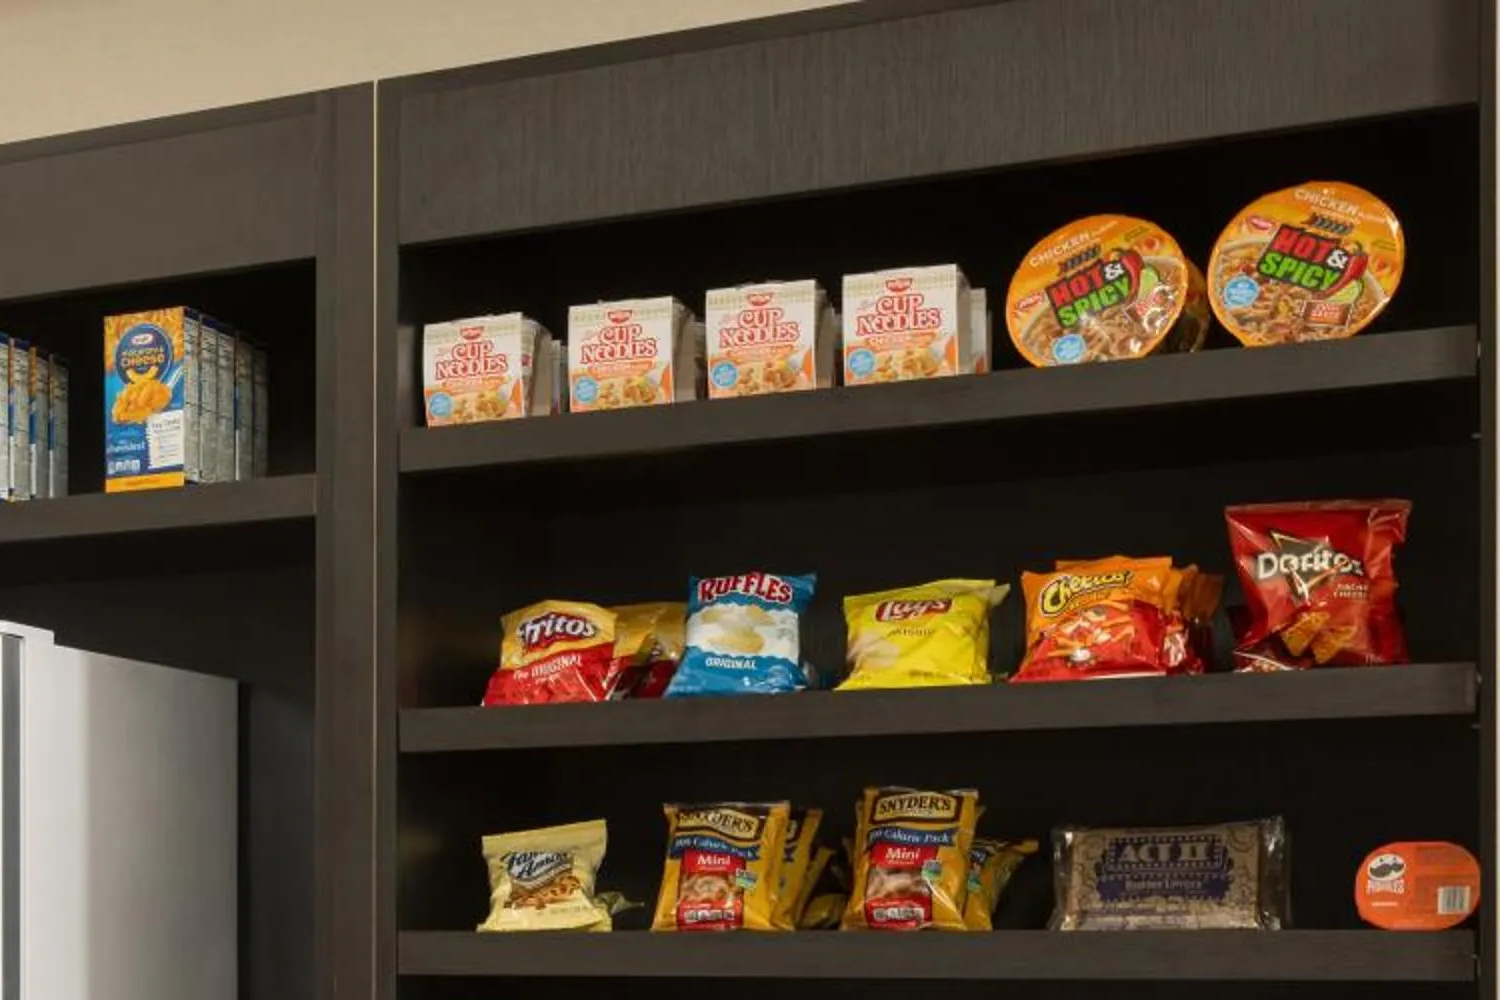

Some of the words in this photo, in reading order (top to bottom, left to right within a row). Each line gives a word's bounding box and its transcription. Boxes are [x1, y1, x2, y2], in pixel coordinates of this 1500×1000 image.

[1029, 232, 1091, 268] CHICKEN
[1271, 226, 1336, 263] HOT
[1326, 249, 1349, 269] &
[1259, 251, 1342, 290] SPICY
[1051, 263, 1103, 307] HOT
[1104, 263, 1125, 281] &
[876, 293, 924, 315] CUP
[1057, 276, 1129, 327] SPICY
[740, 308, 784, 328] CUP
[855, 307, 942, 336] NOODLES
[600, 323, 642, 344] CUP
[719, 321, 800, 348] NOODLES
[452, 339, 493, 361] CUP
[580, 337, 658, 364] NOODLES
[435, 352, 508, 381] NOODLES
[698, 571, 793, 604] RUFFLES
[516, 613, 596, 644] Fritos
[532, 655, 582, 677] ORIGINAL
[705, 656, 757, 670] ORIGINAL
[697, 855, 731, 866] Mini
[885, 847, 921, 860] Mini
